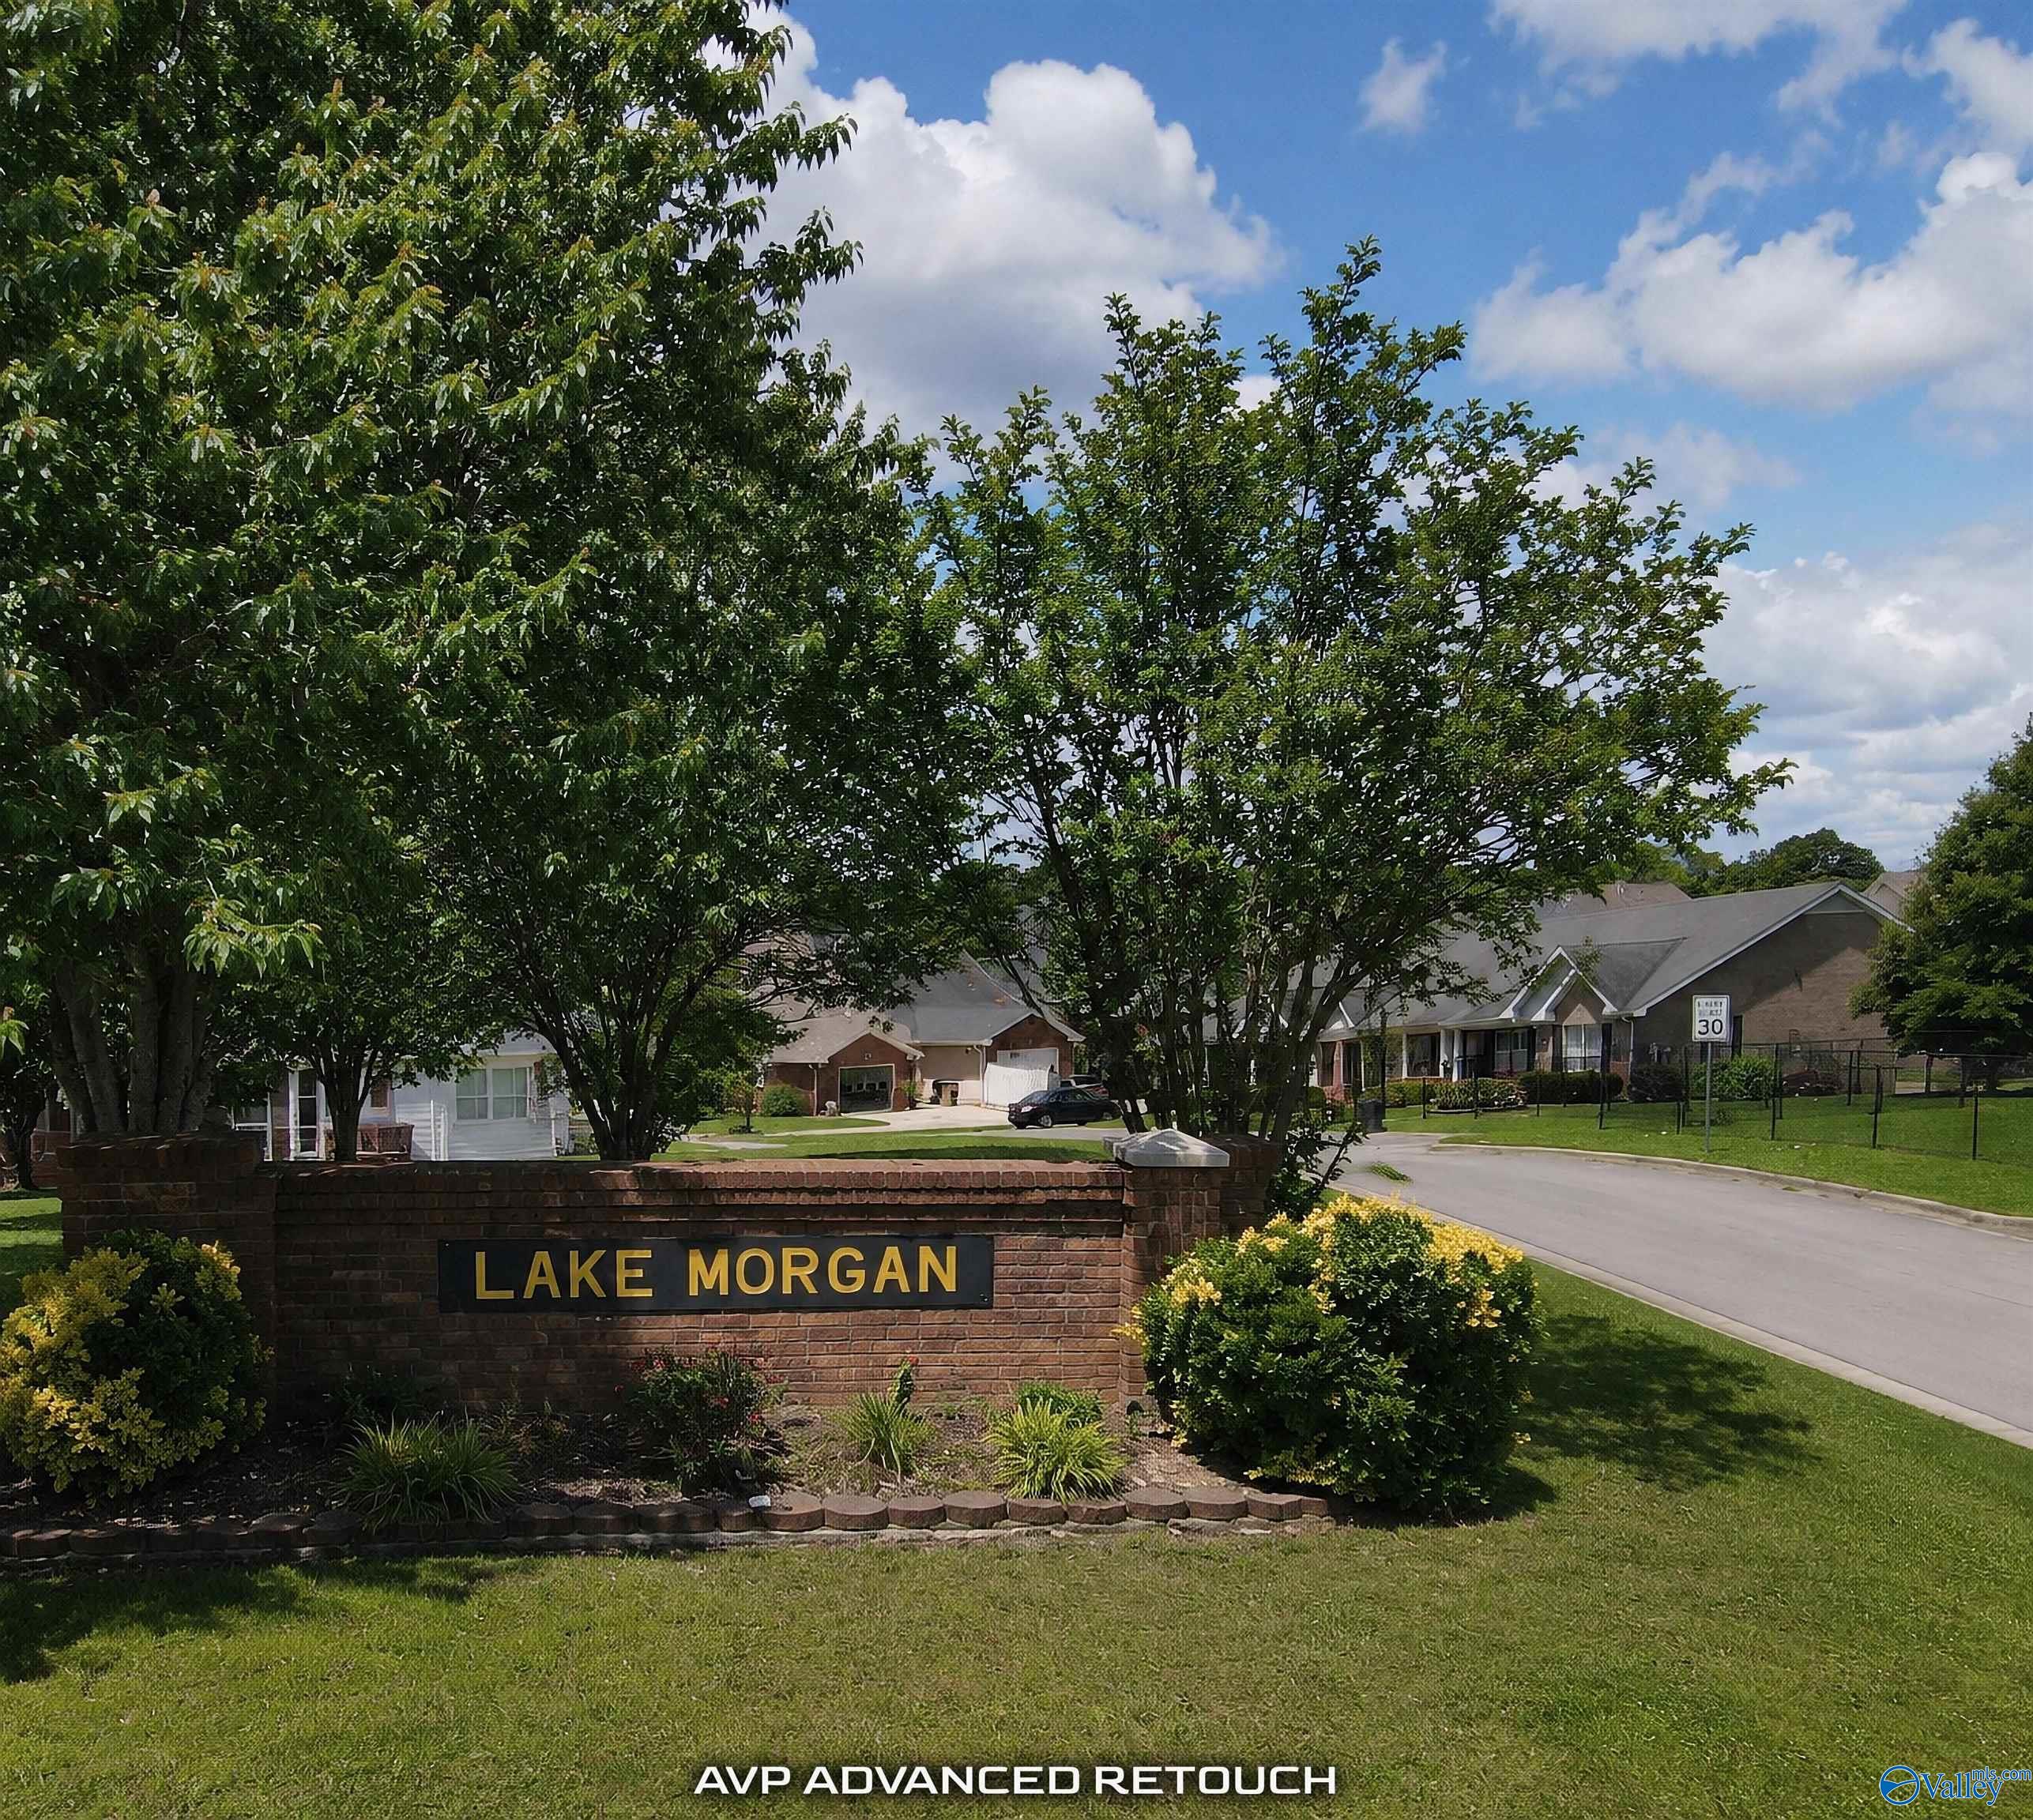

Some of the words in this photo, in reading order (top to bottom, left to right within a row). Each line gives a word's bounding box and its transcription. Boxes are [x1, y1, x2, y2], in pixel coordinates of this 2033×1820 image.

[1698, 1019, 1723, 1036] 30
[474, 1249, 654, 1299] LAKE
[688, 1245, 958, 1297] MORGAN
